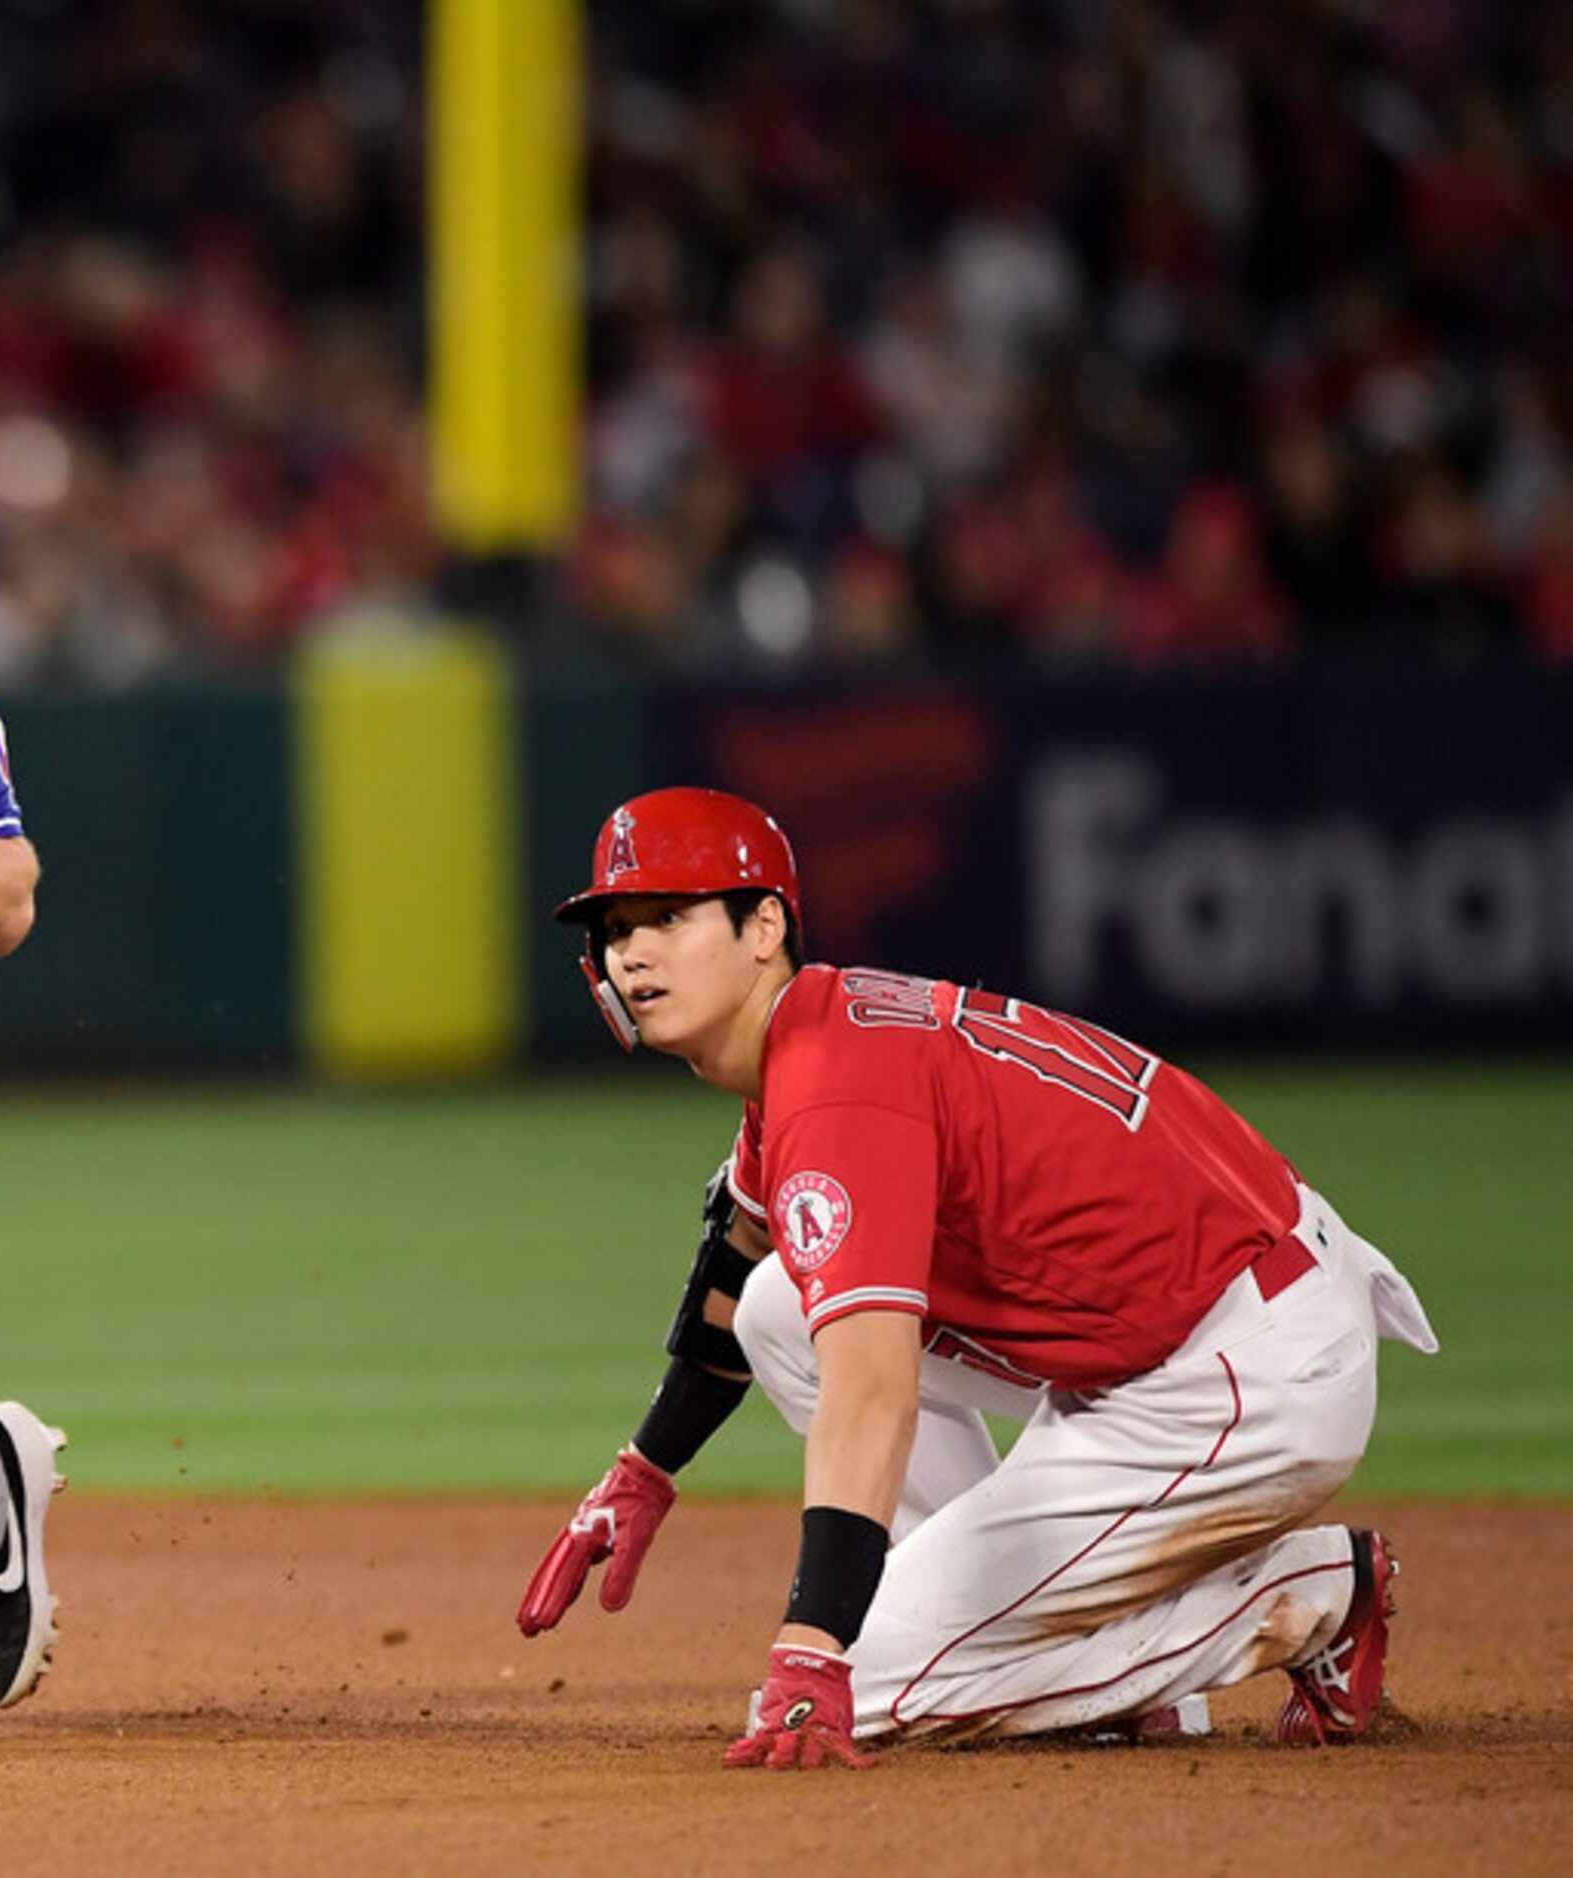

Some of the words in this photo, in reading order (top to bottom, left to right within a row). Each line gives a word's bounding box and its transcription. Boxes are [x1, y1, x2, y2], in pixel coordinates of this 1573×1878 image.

[606, 814, 639, 886] A
[952, 985, 1161, 1132] 17
[796, 1200, 824, 1249] A
